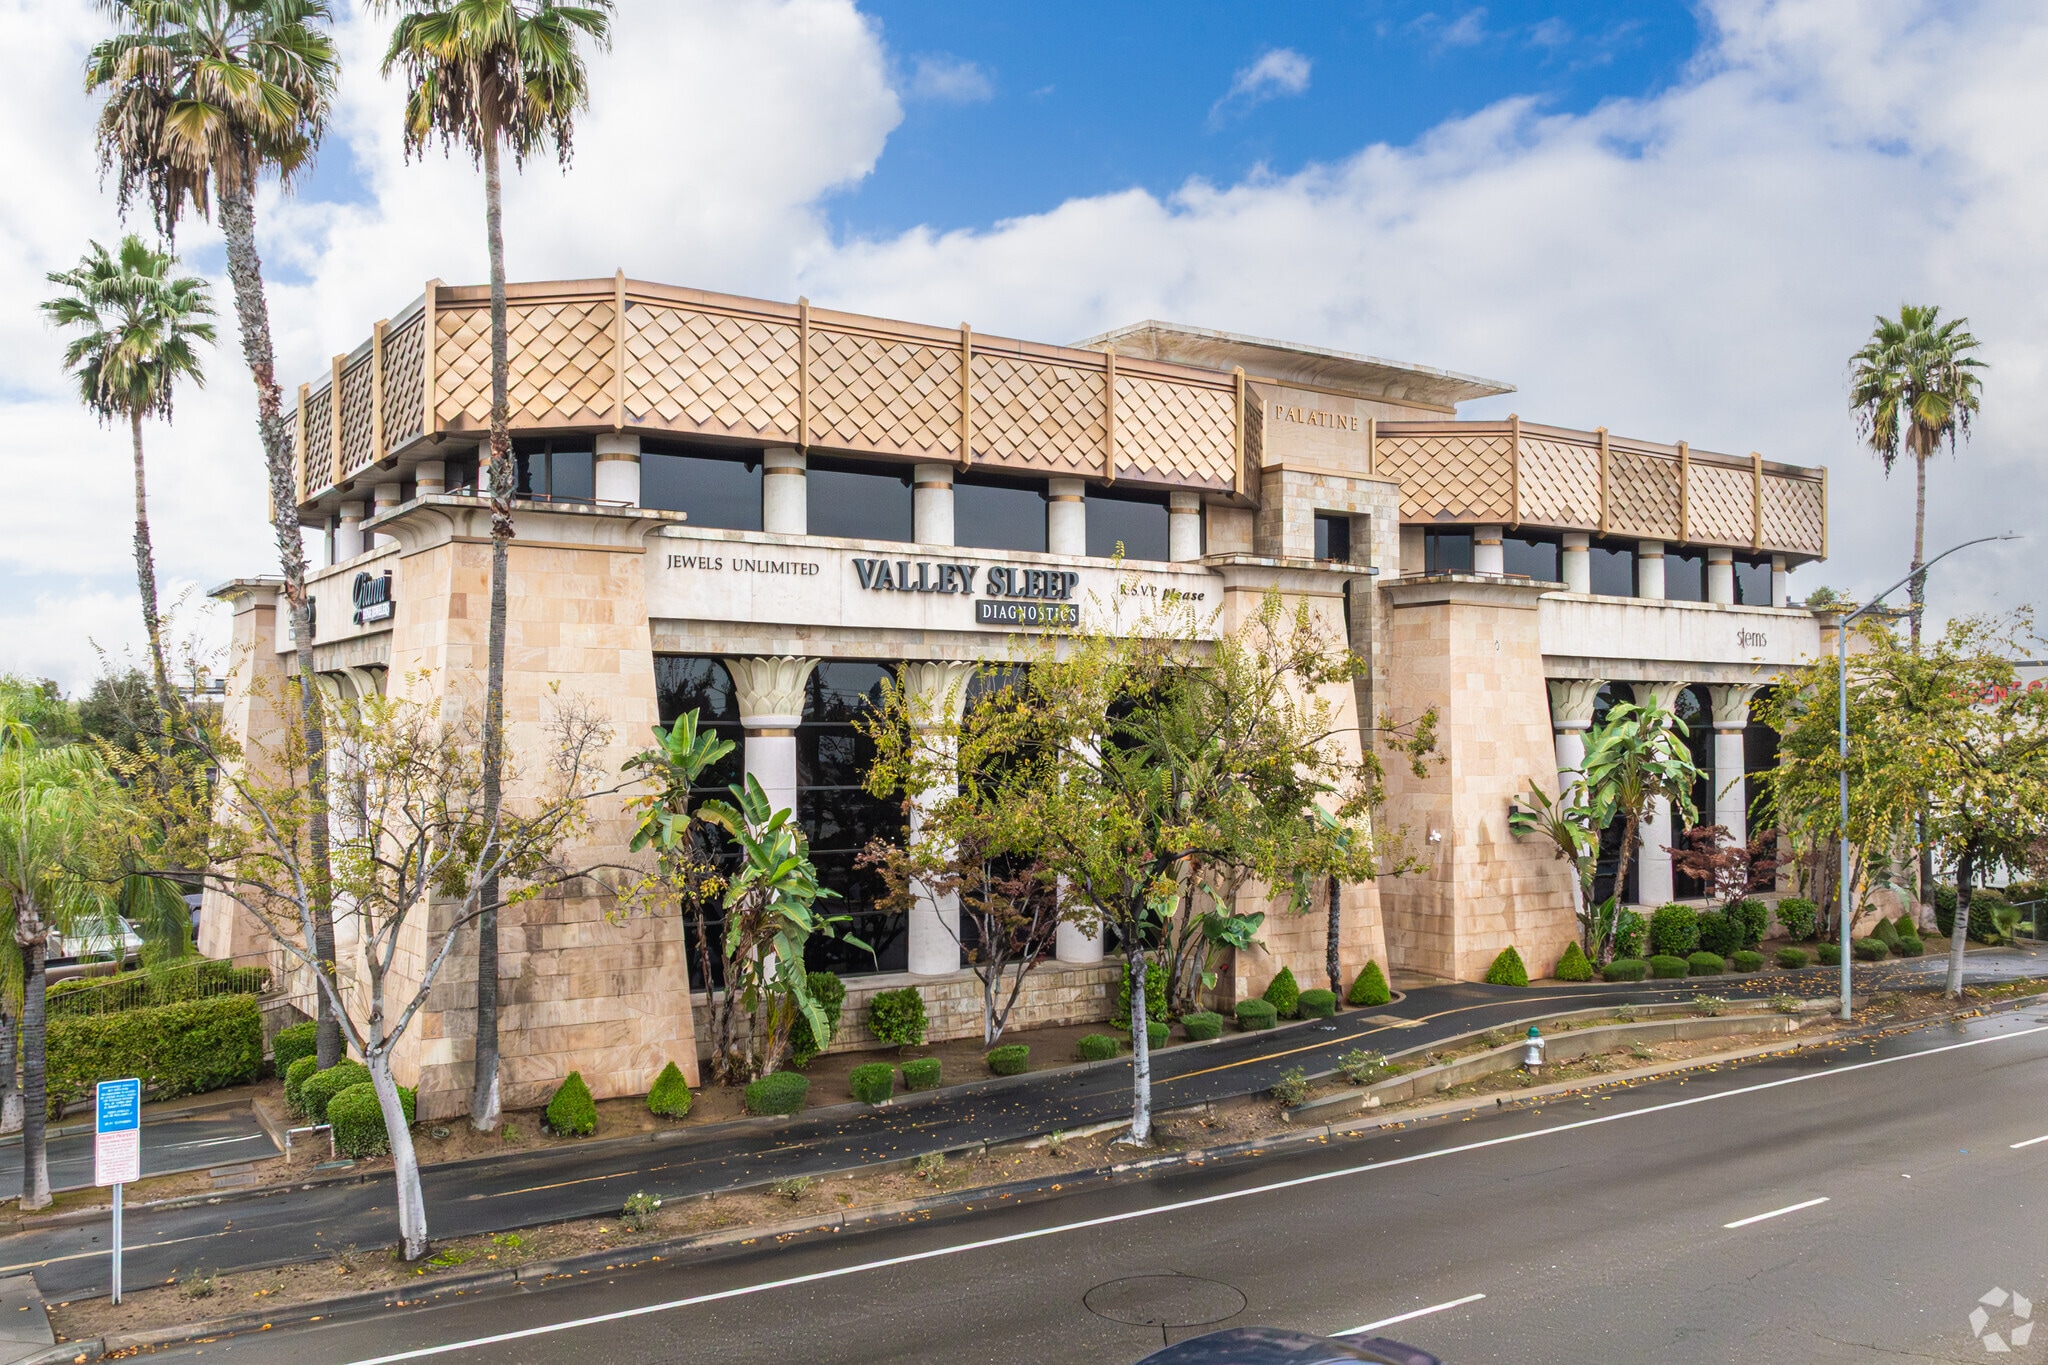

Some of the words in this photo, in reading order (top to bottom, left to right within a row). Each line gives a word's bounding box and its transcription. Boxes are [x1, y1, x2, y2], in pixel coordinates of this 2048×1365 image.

[1276, 404, 1358, 431] PALATINE
[667, 554, 723, 571] JEWELS
[732, 558, 820, 576] UNLIMITED
[852, 558, 980, 595] VALLEY
[986, 566, 1080, 600] SLEEP
[982, 604, 1077, 622] DIAGNOSTICS
